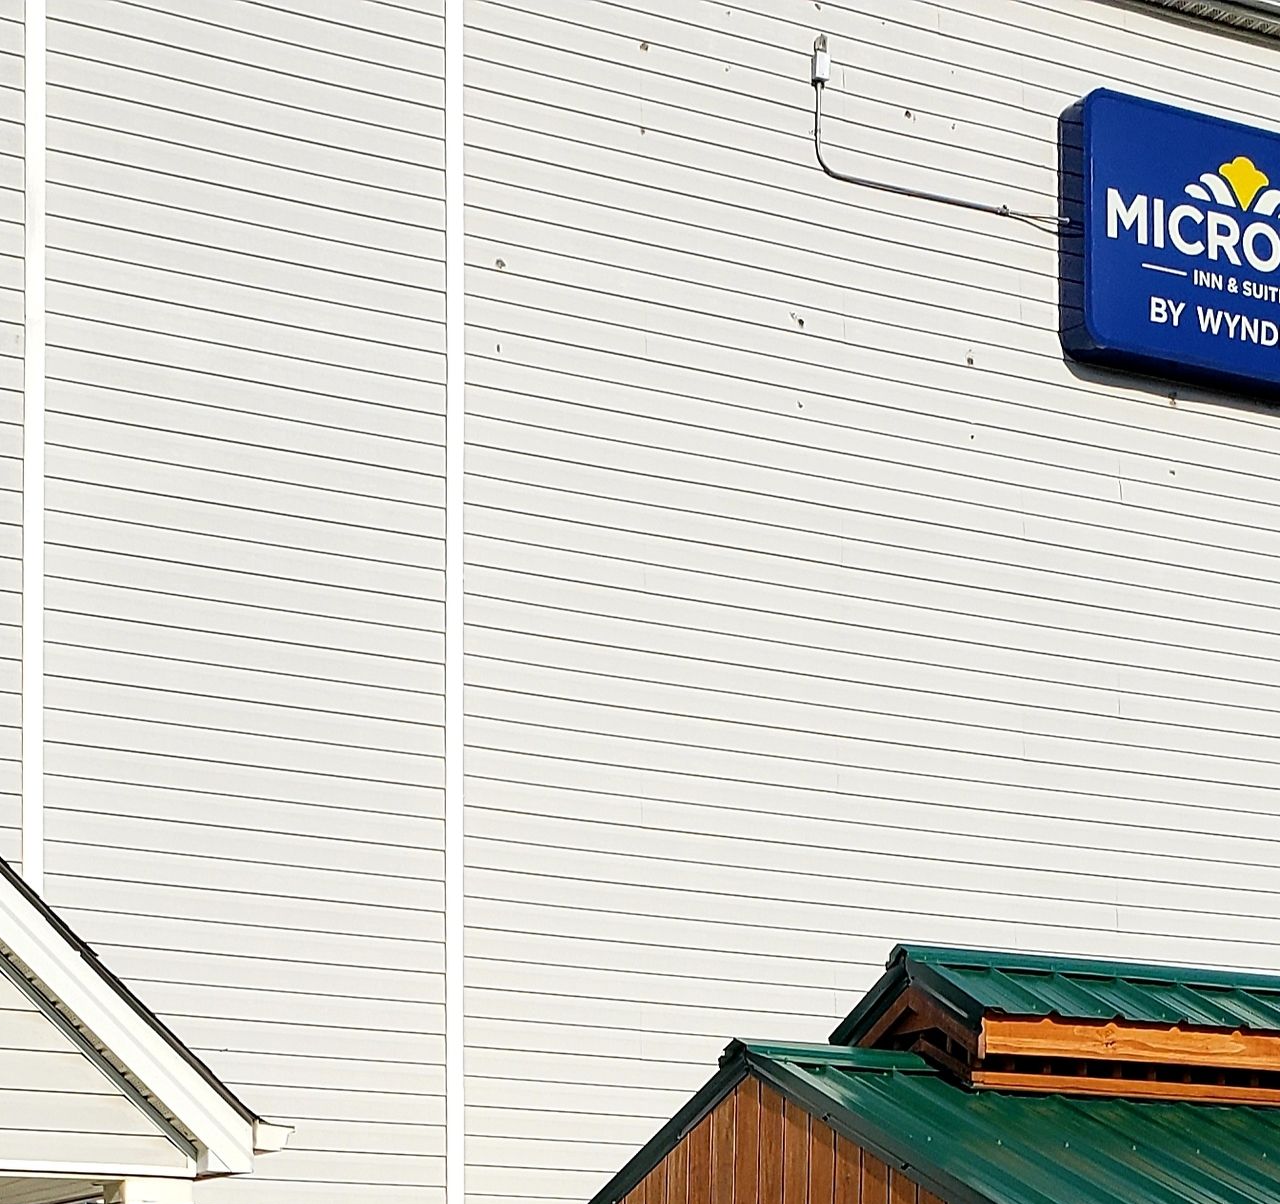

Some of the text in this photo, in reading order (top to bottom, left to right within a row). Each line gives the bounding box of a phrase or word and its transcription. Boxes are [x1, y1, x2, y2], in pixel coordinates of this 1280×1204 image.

[1193, 269, 1223, 292] INN
[1227, 277, 1239, 295] &
[1150, 296, 1185, 327] BY
